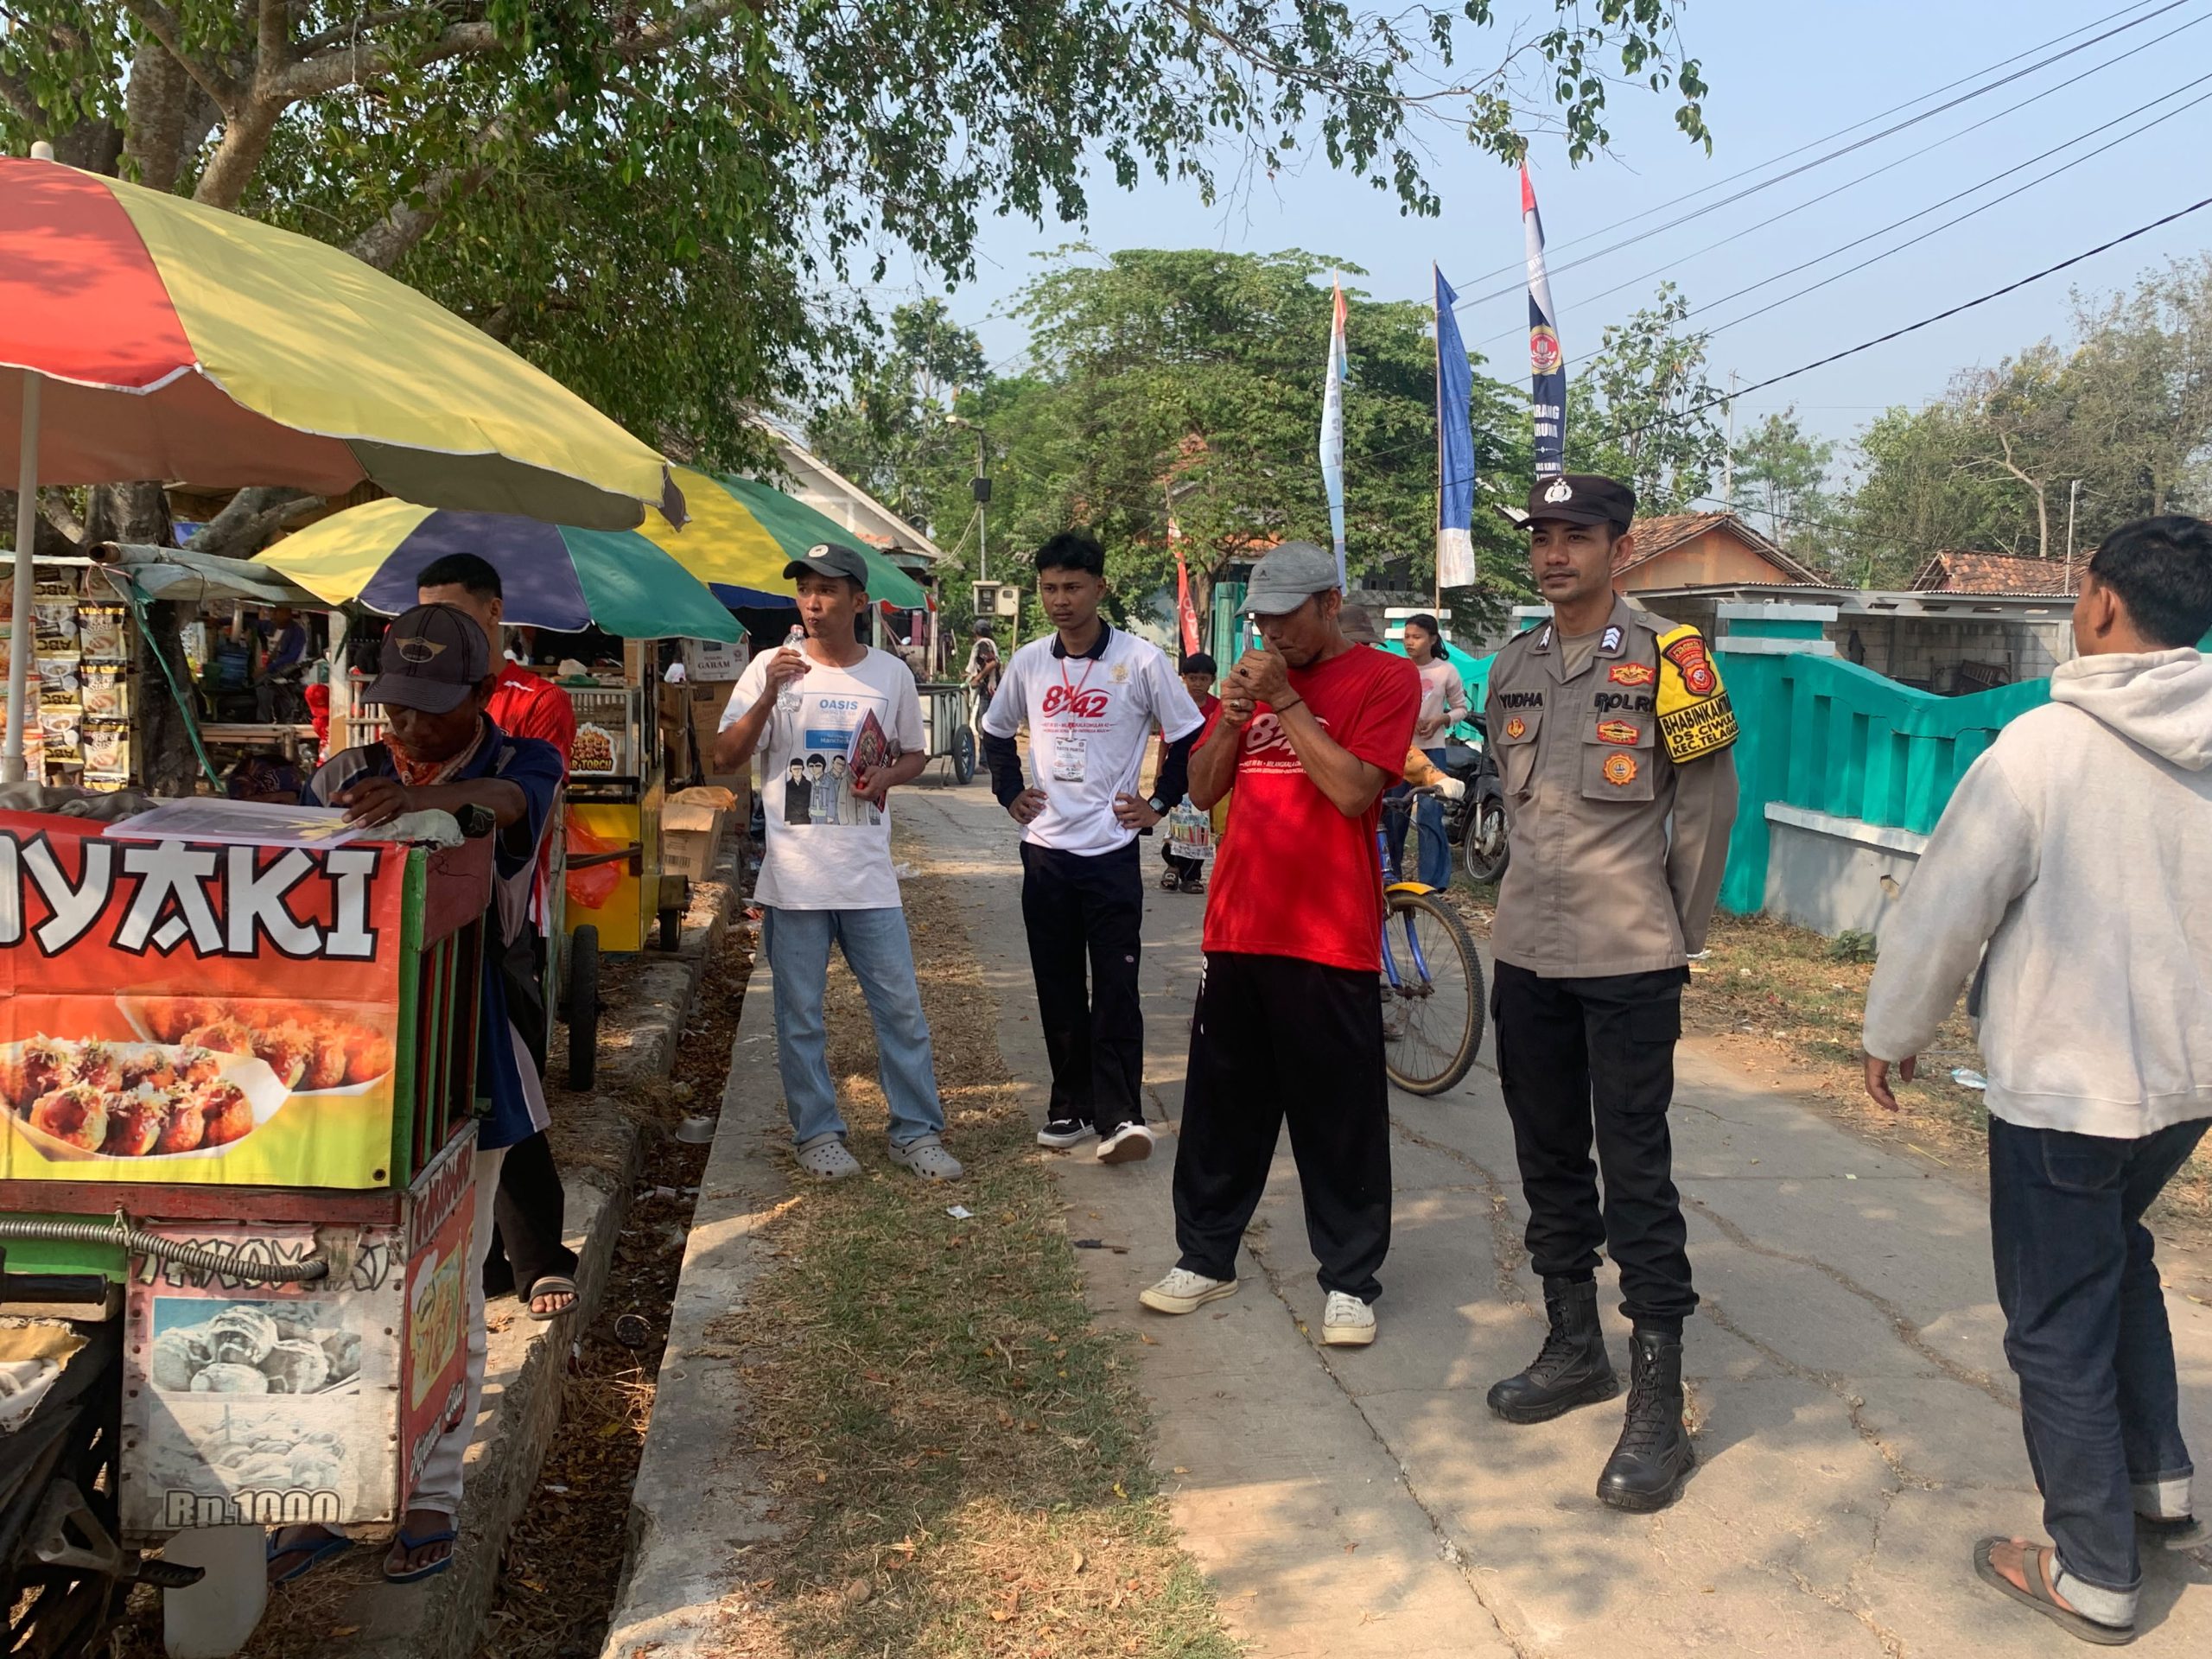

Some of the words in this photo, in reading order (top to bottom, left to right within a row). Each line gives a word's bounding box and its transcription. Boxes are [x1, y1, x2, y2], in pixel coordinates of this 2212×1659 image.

[35, 584, 71, 595] ABC
[37, 639, 73, 651] ABC
[697, 660, 730, 669] GARAM
[41, 694, 73, 705] ABC
[819, 699, 858, 710] OASIS
[1499, 692, 1543, 709] YUDHA
[1594, 692, 1655, 713] POLRI
[45, 747, 74, 759] ABC
[581, 759, 613, 770] TORCH
